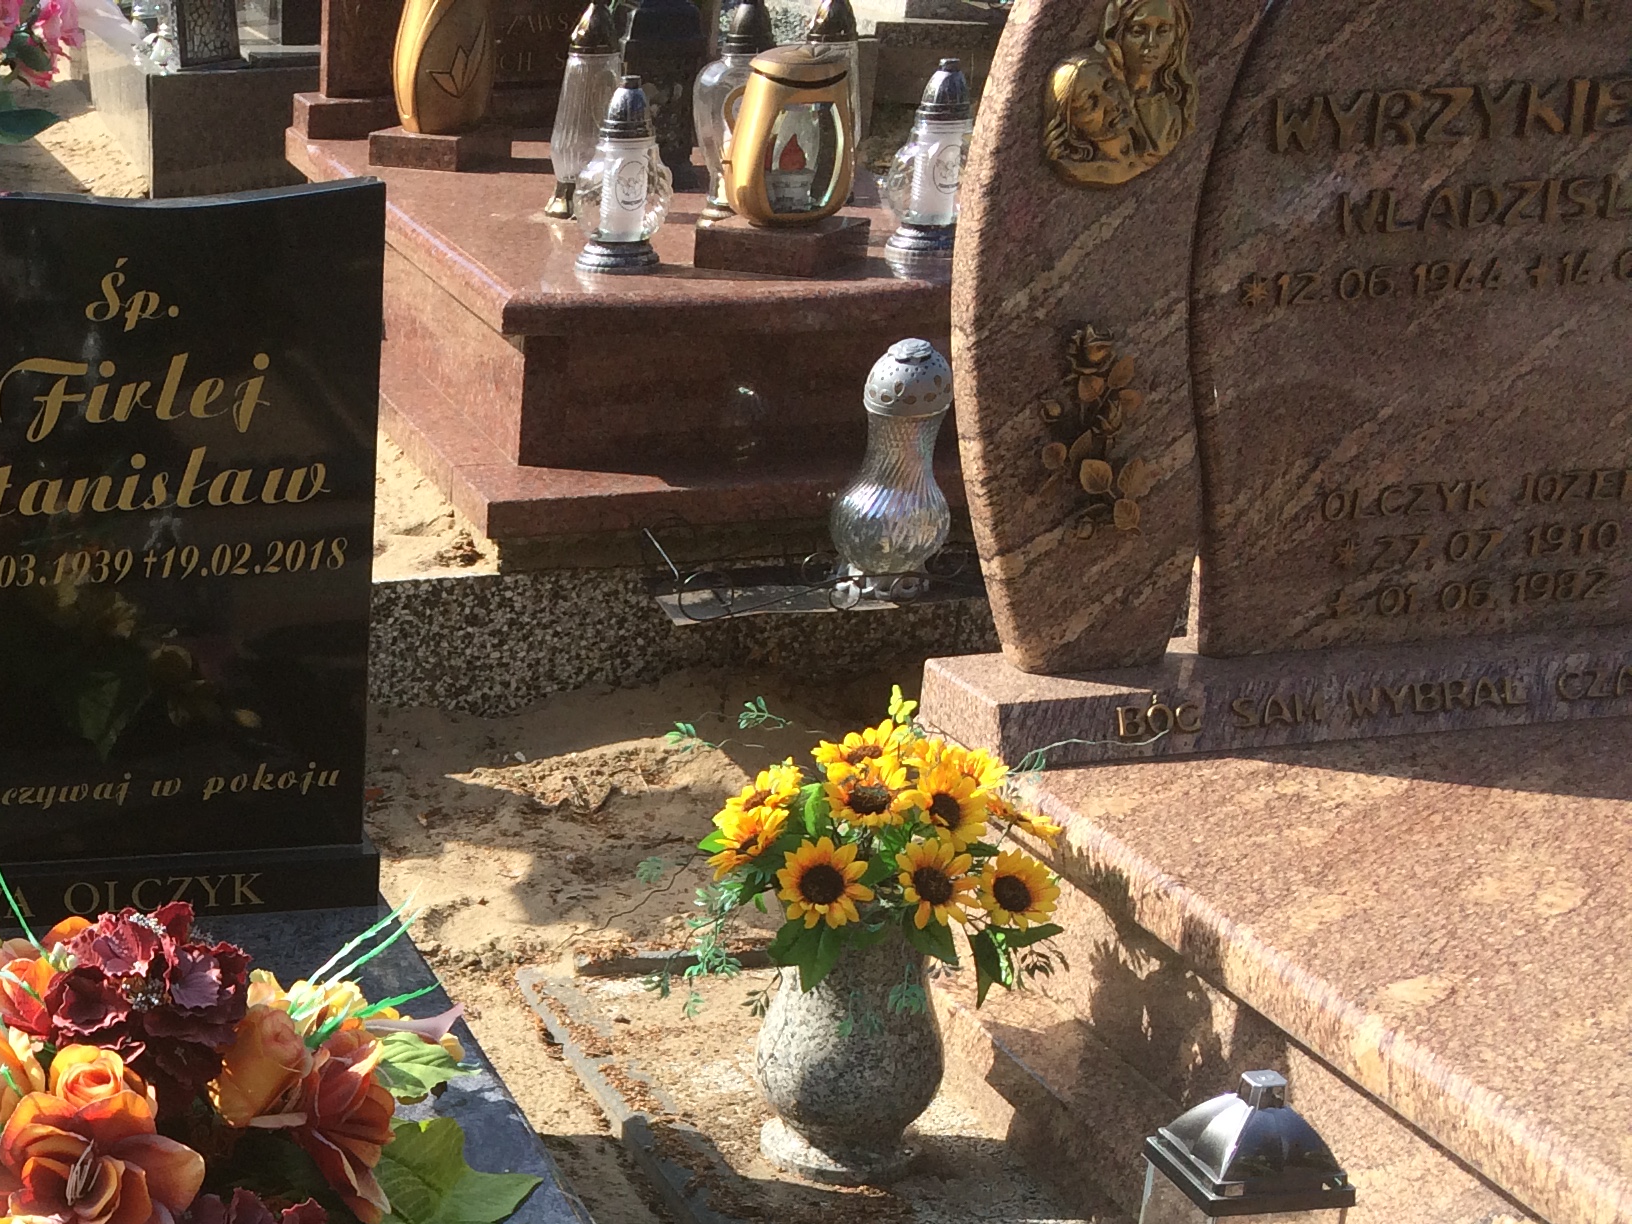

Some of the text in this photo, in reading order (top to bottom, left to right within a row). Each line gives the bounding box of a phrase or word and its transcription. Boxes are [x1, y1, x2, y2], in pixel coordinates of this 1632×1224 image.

[85, 257, 180, 332] Śp.
[160, 536, 349, 579] 19.02.2018
[151, 777, 182, 798] w
[202, 761, 341, 801] pokoju
